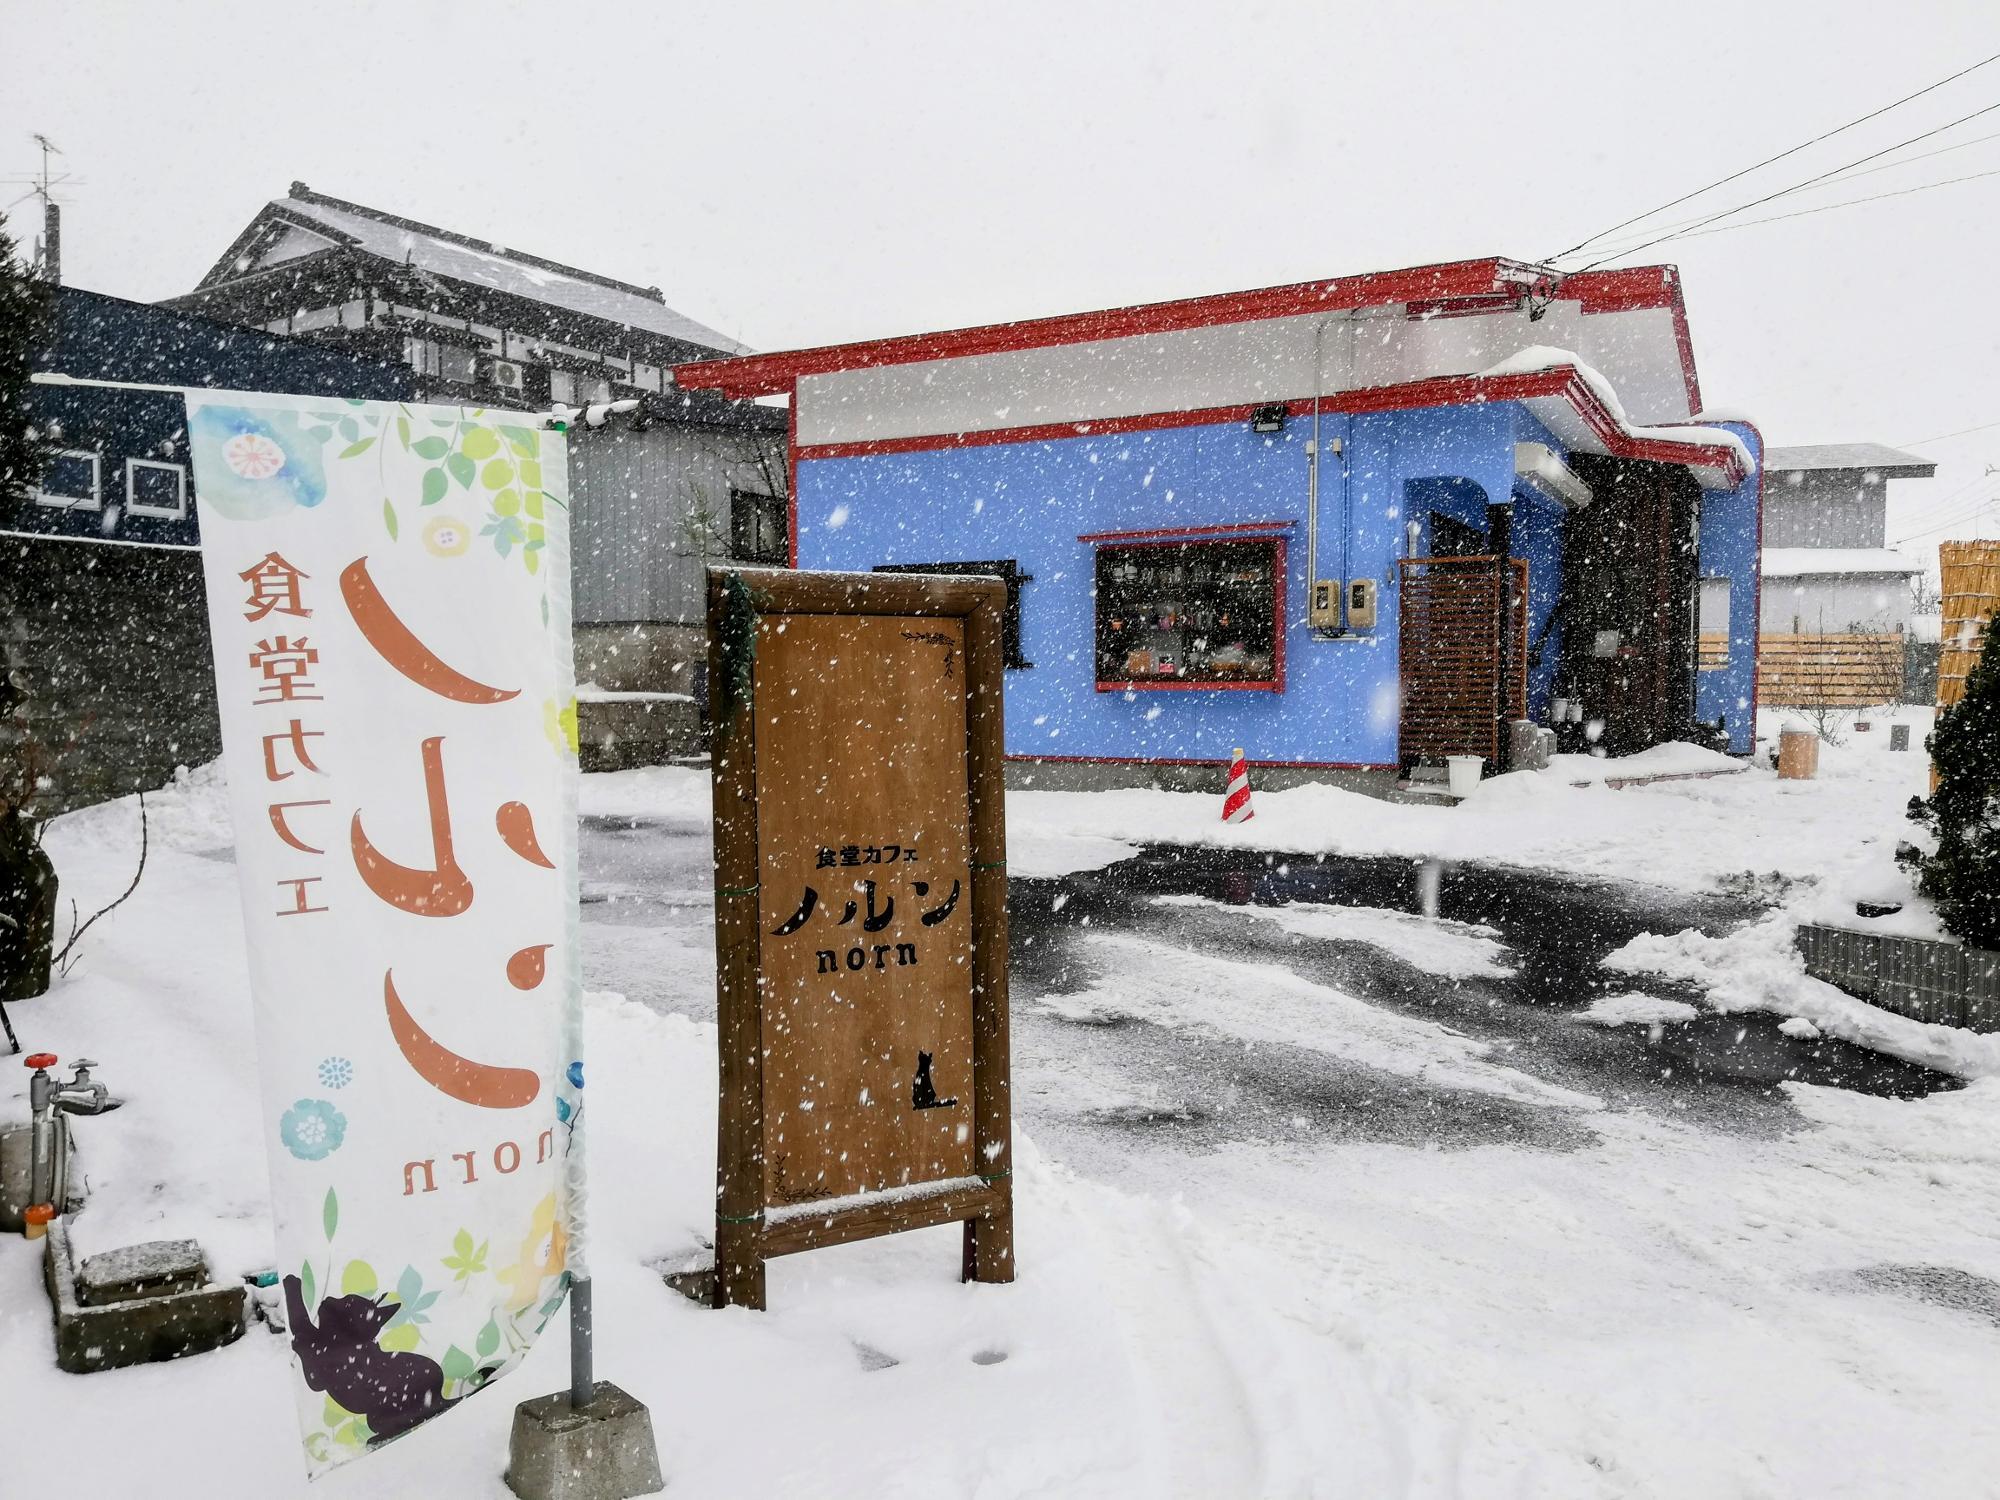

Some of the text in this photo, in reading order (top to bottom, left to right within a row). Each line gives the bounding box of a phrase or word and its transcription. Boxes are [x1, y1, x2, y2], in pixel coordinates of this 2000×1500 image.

[815, 845, 919, 870] 食堂カフェ
[769, 879, 960, 936] ノルン
[815, 943, 918, 974] norn
